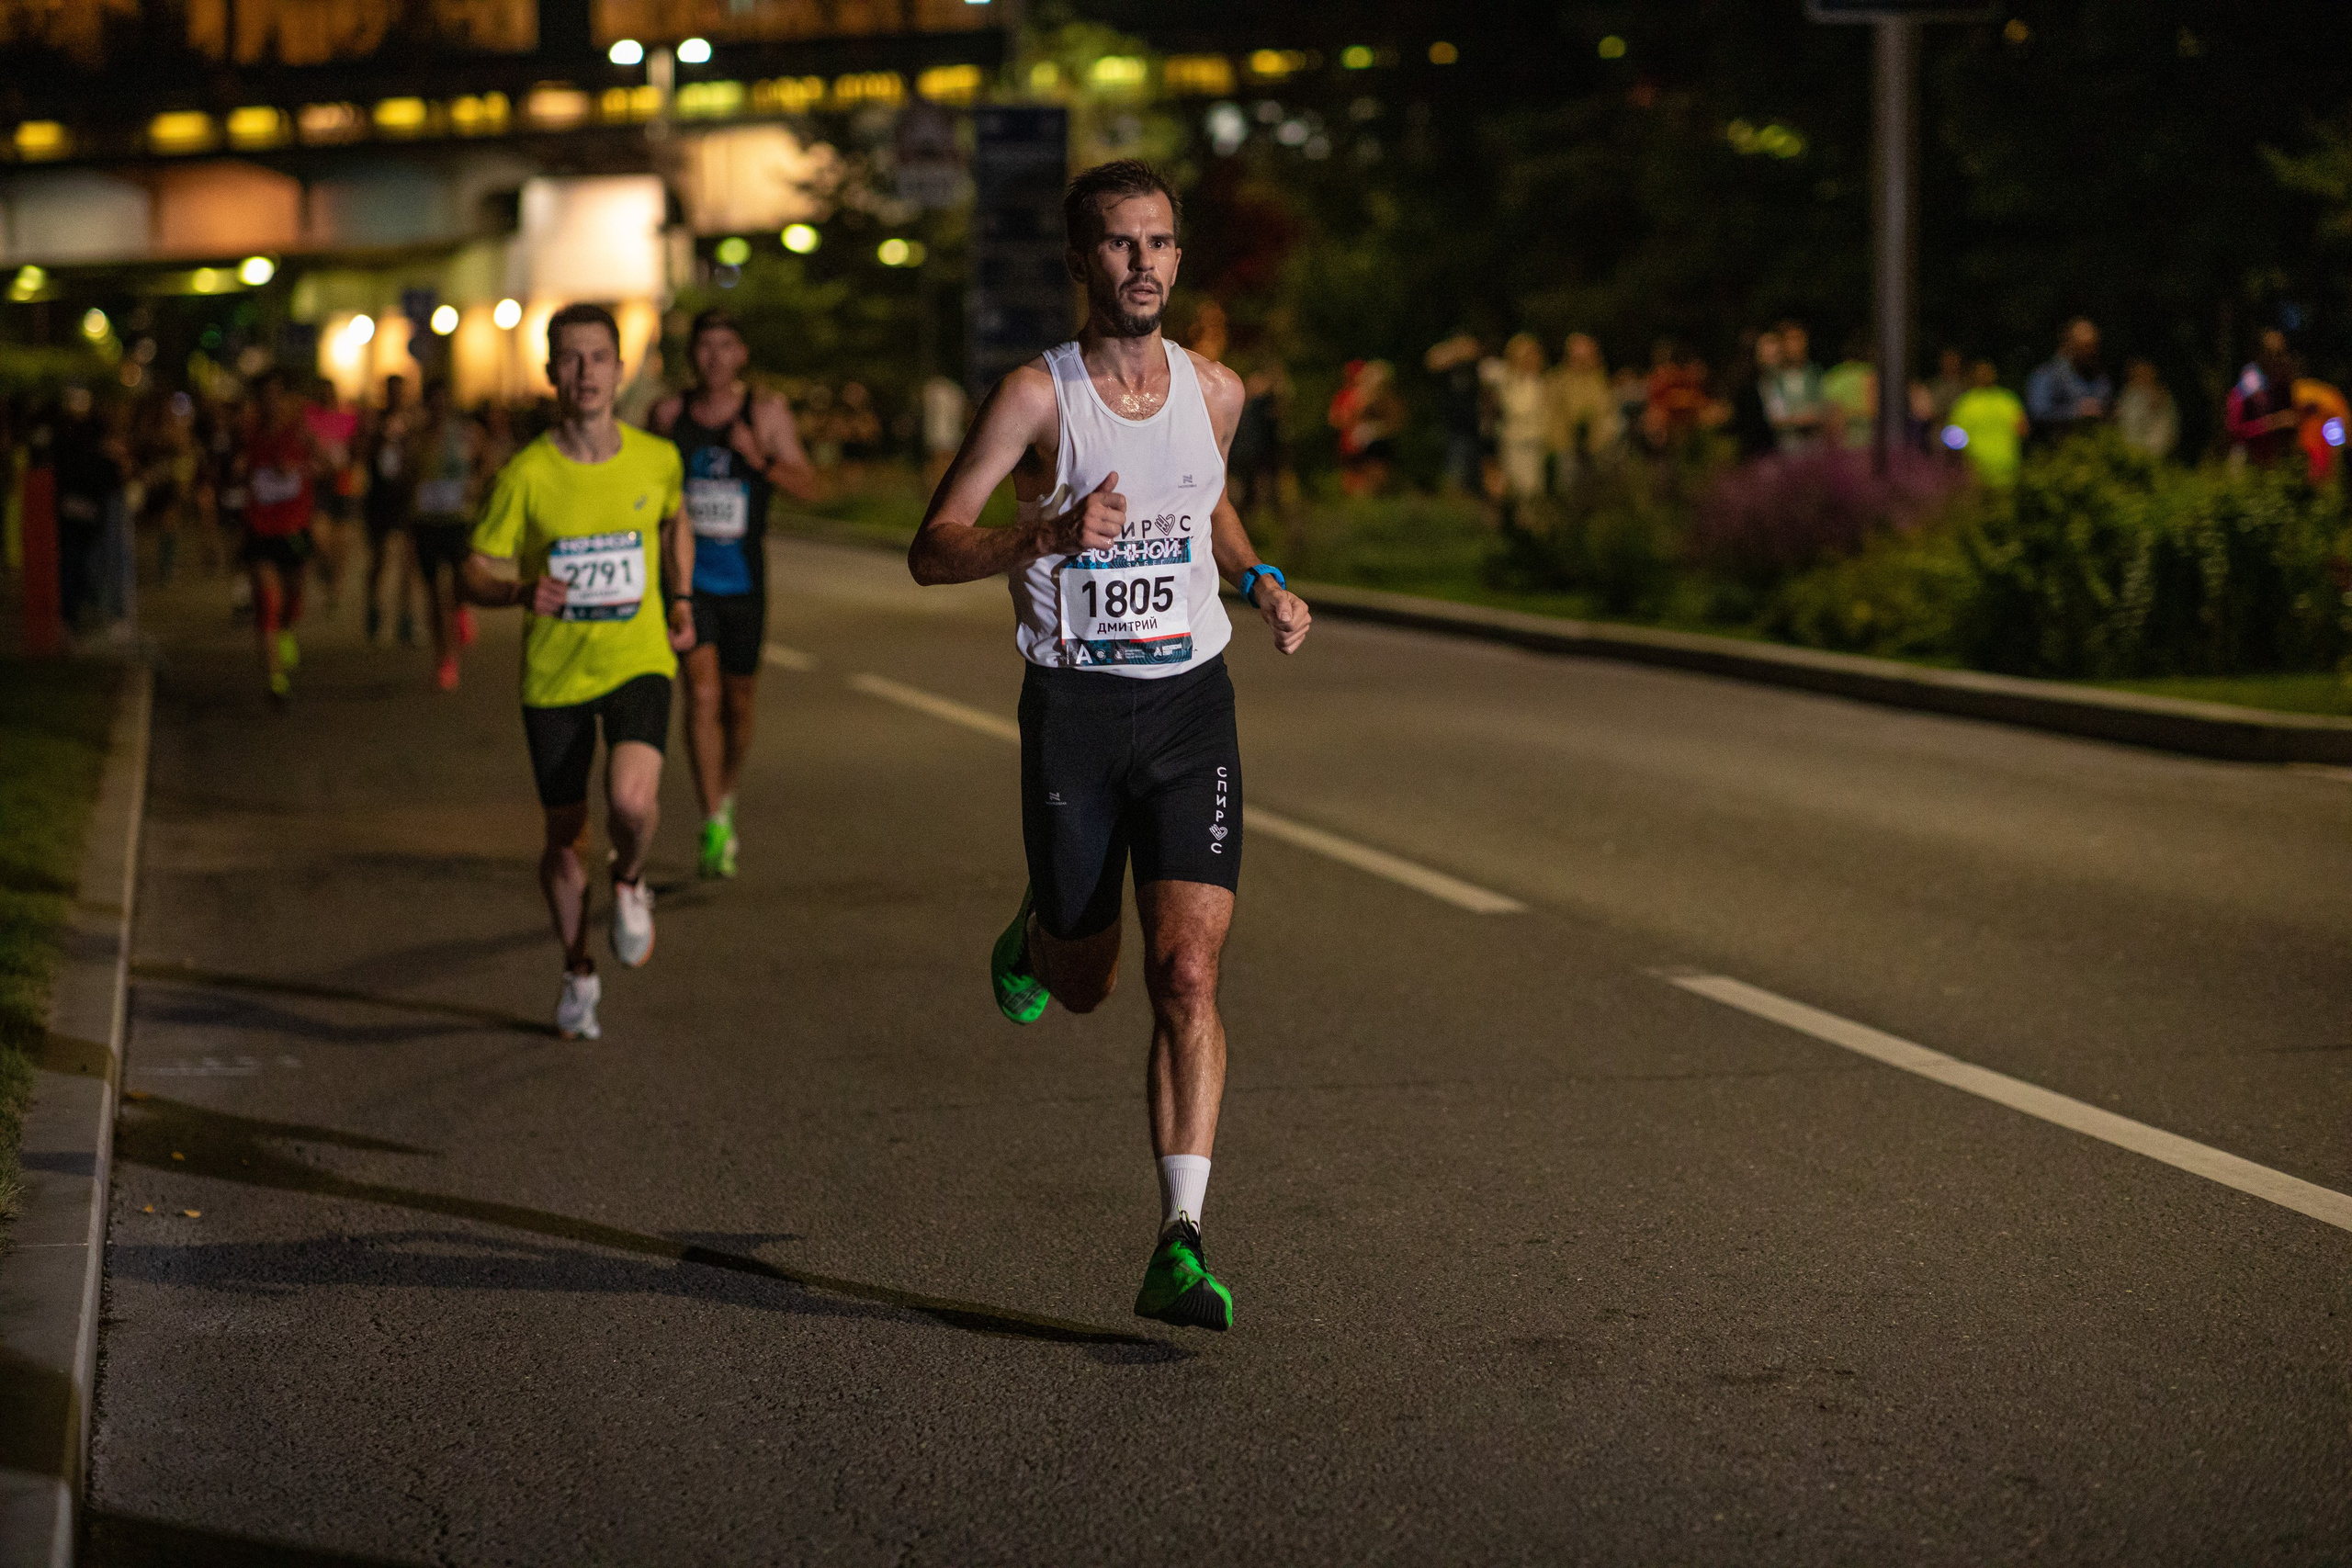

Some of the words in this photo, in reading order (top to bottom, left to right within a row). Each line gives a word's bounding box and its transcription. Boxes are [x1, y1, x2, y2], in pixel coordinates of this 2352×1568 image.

[564, 559, 631, 590] 2791
[1081, 575, 1175, 618] 1805
[1097, 616, 1159, 634] ДМИТРИЙ
